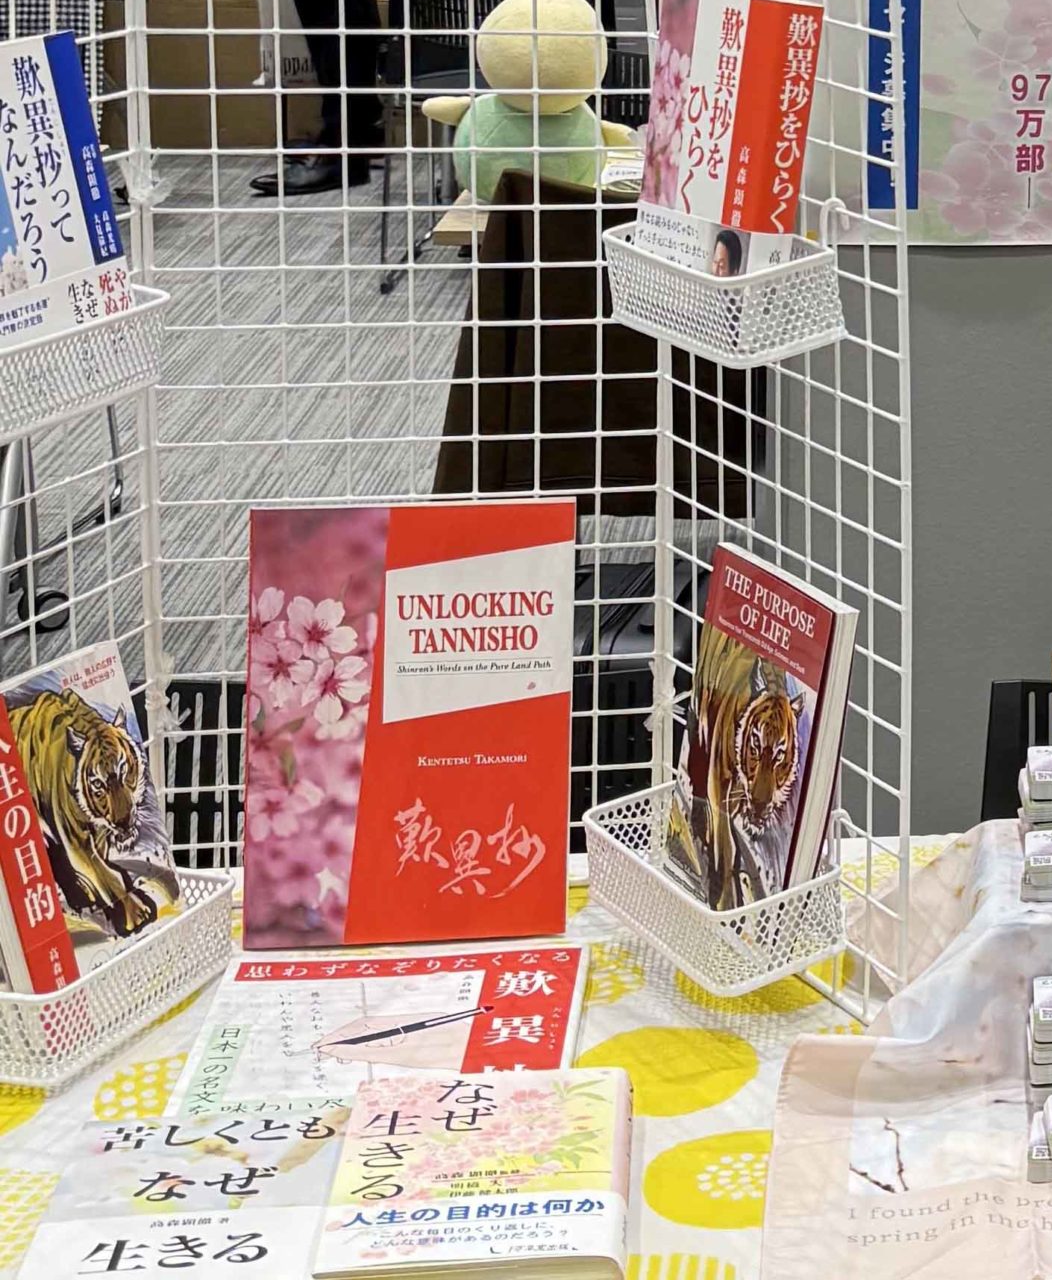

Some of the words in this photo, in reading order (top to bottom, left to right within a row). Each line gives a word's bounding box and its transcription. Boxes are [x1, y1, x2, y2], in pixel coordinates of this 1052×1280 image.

[707, 7, 744, 179] 歎異抄を
[770, 13, 818, 234] 歎異抄をひらく
[11, 55, 75, 243] 歎異抄って
[680, 85, 708, 215] ひらく
[0, 99, 48, 284] なんだろう
[397, 591, 554, 621] UNLOCKING
[725, 566, 752, 599] THE
[754, 583, 816, 638] PURPOSE
[409, 625, 538, 654] TANNISHO
[740, 604, 760, 629] OF
[760, 615, 791, 650] LIFE
[397, 665, 434, 673] Shinran's
[437, 664, 461, 672] Words
[475, 663, 488, 671] the
[490, 662, 509, 671] Pure
[511, 661, 531, 670] Land
[534, 660, 551, 668] Path
[244, 950, 571, 979] 思わずなぞりたくなる
[481, 970, 558, 1075] 歎異
[188, 1027, 242, 1104] 日本一の名文
[431, 1079, 498, 1132] なぜ
[101, 1117, 335, 1153] 苦しくとも
[350, 1110, 422, 1200] 生きる
[133, 1166, 279, 1202] なぜ
[848, 1207, 858, 1221] I
[869, 1198, 953, 1221] found
[963, 1191, 1006, 1206] the
[342, 1198, 605, 1228] 人生の目的は何か
[846, 1225, 940, 1248] spring
[949, 1213, 976, 1233] in
[77, 1232, 269, 1275] 生きる
